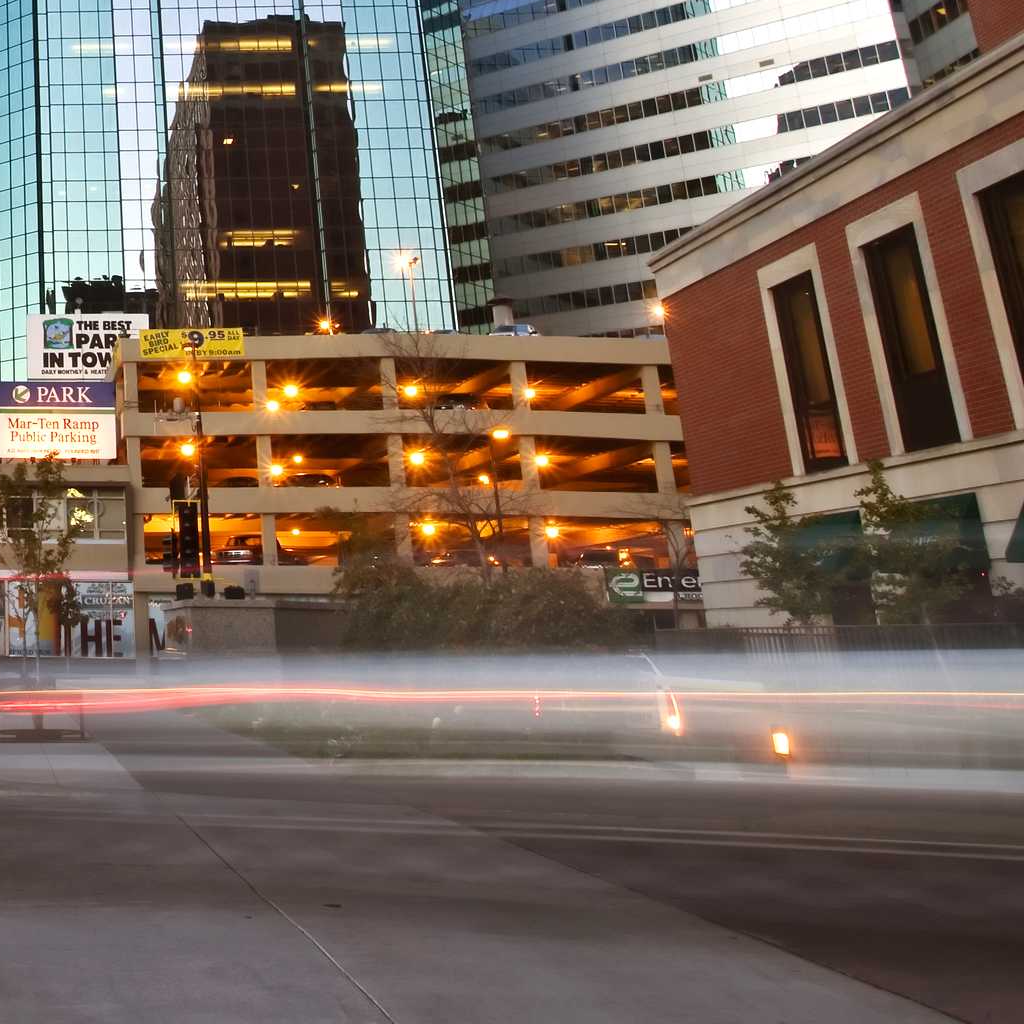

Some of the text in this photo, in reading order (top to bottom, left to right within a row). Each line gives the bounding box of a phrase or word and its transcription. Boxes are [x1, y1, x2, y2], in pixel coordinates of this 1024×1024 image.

[76, 321, 132, 330] THE BEST
[76, 334, 131, 349] PAR
[144, 331, 169, 342] EARLY
[149, 339, 169, 348] BIRD
[143, 344, 179, 356] SPECIAL
[43, 352, 112, 368] IN TOW
[37, 386, 93, 403] PARK
[8, 418, 99, 432] Mar-Ten Ramp
[10, 431, 97, 445] Public Parking
